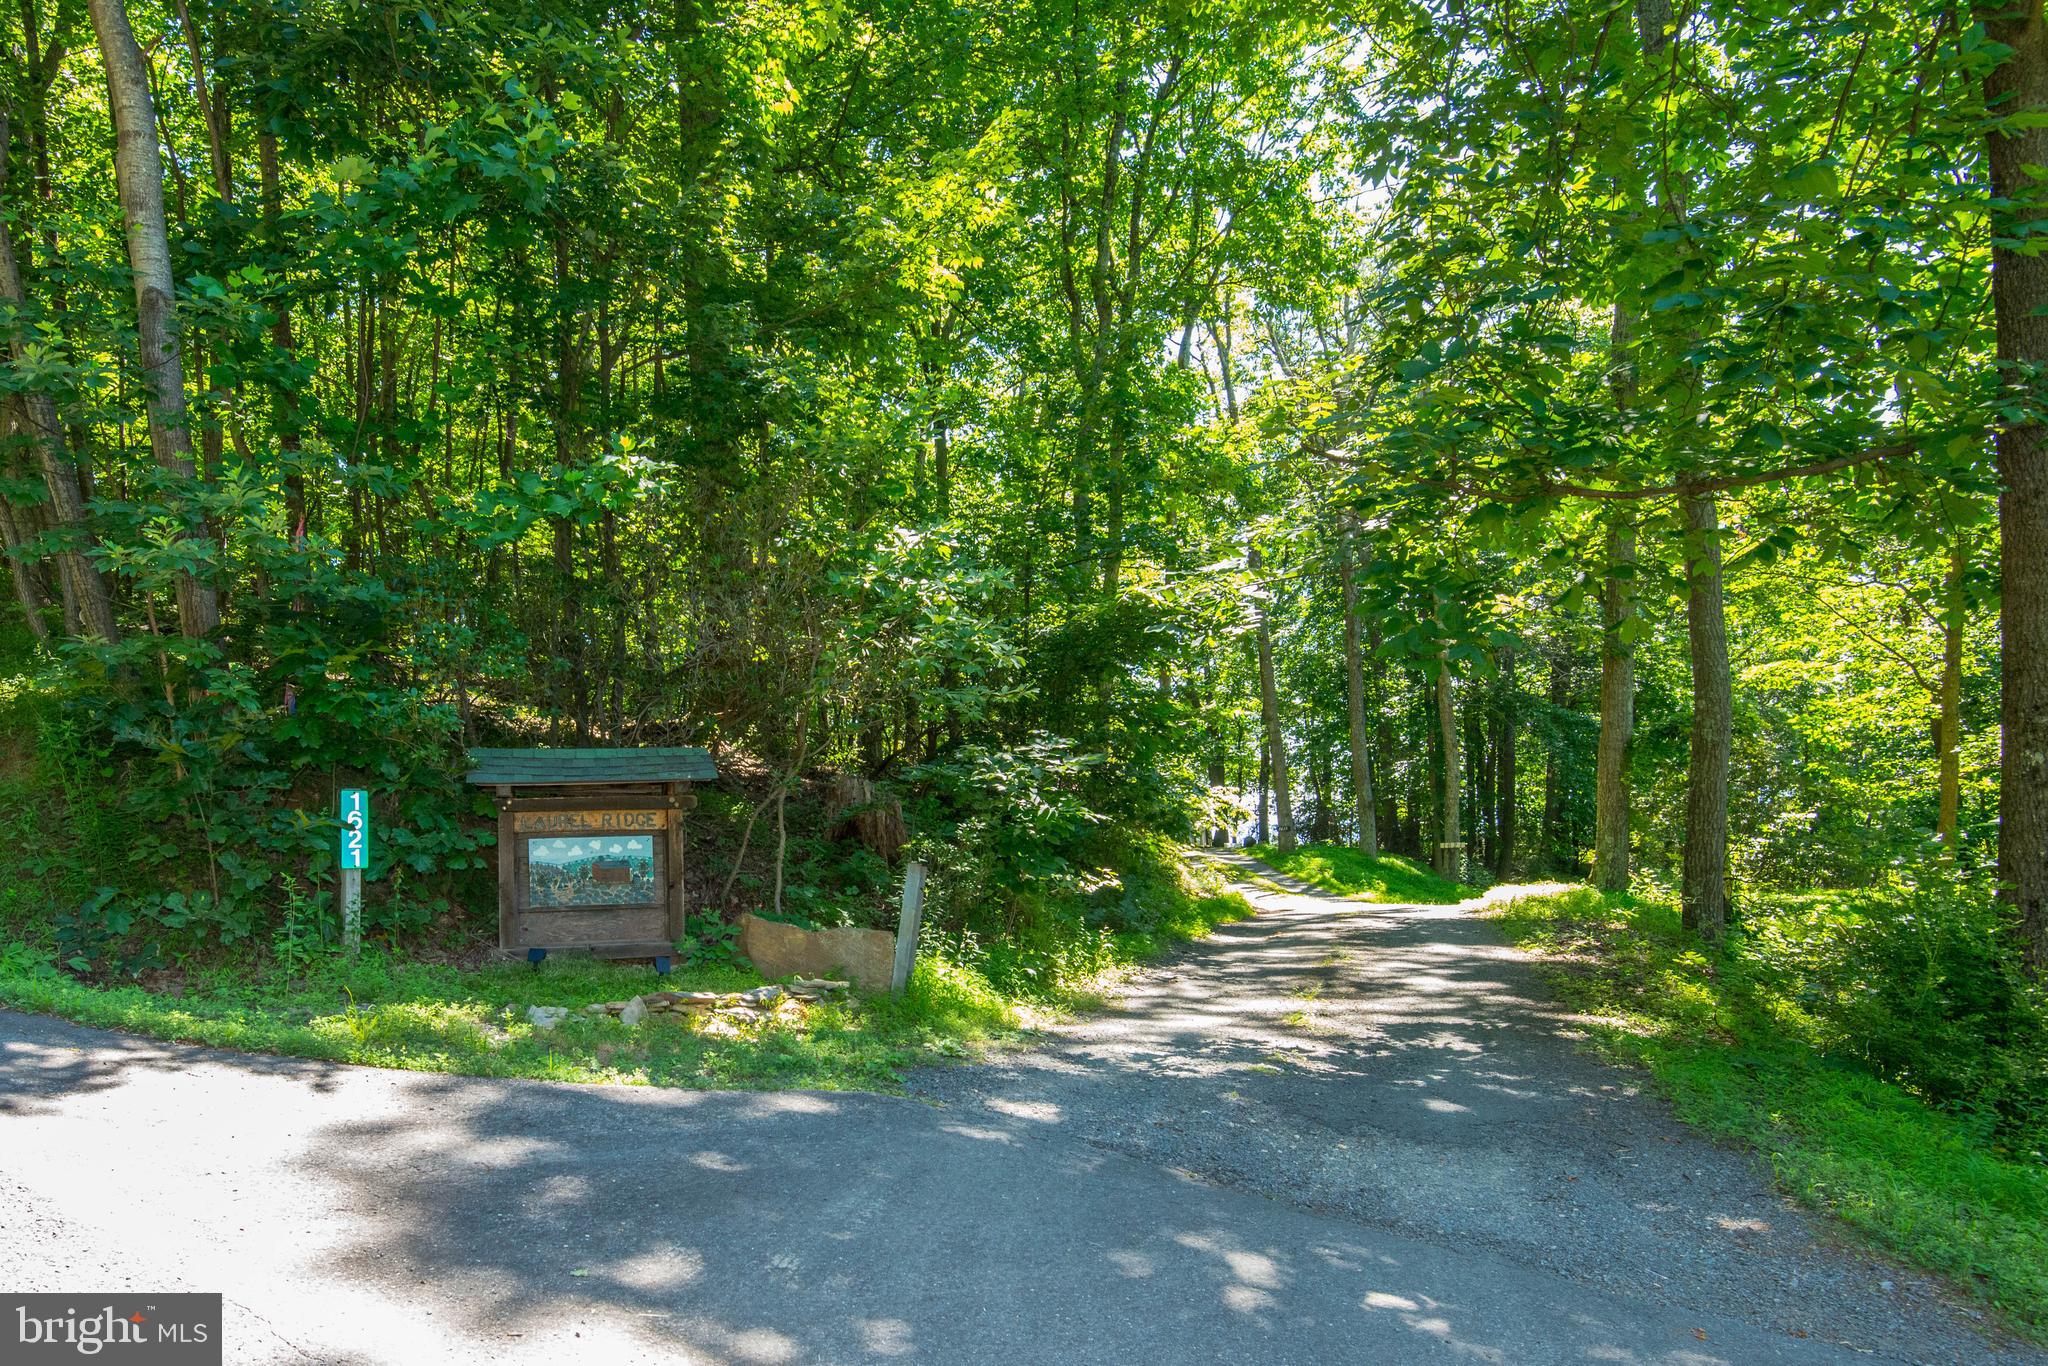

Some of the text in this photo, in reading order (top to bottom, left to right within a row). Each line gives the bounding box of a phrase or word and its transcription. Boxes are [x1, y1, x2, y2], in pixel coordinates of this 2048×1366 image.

[347, 792, 363, 867] 1621
[520, 812, 657, 831] LAUREL RIDGE
